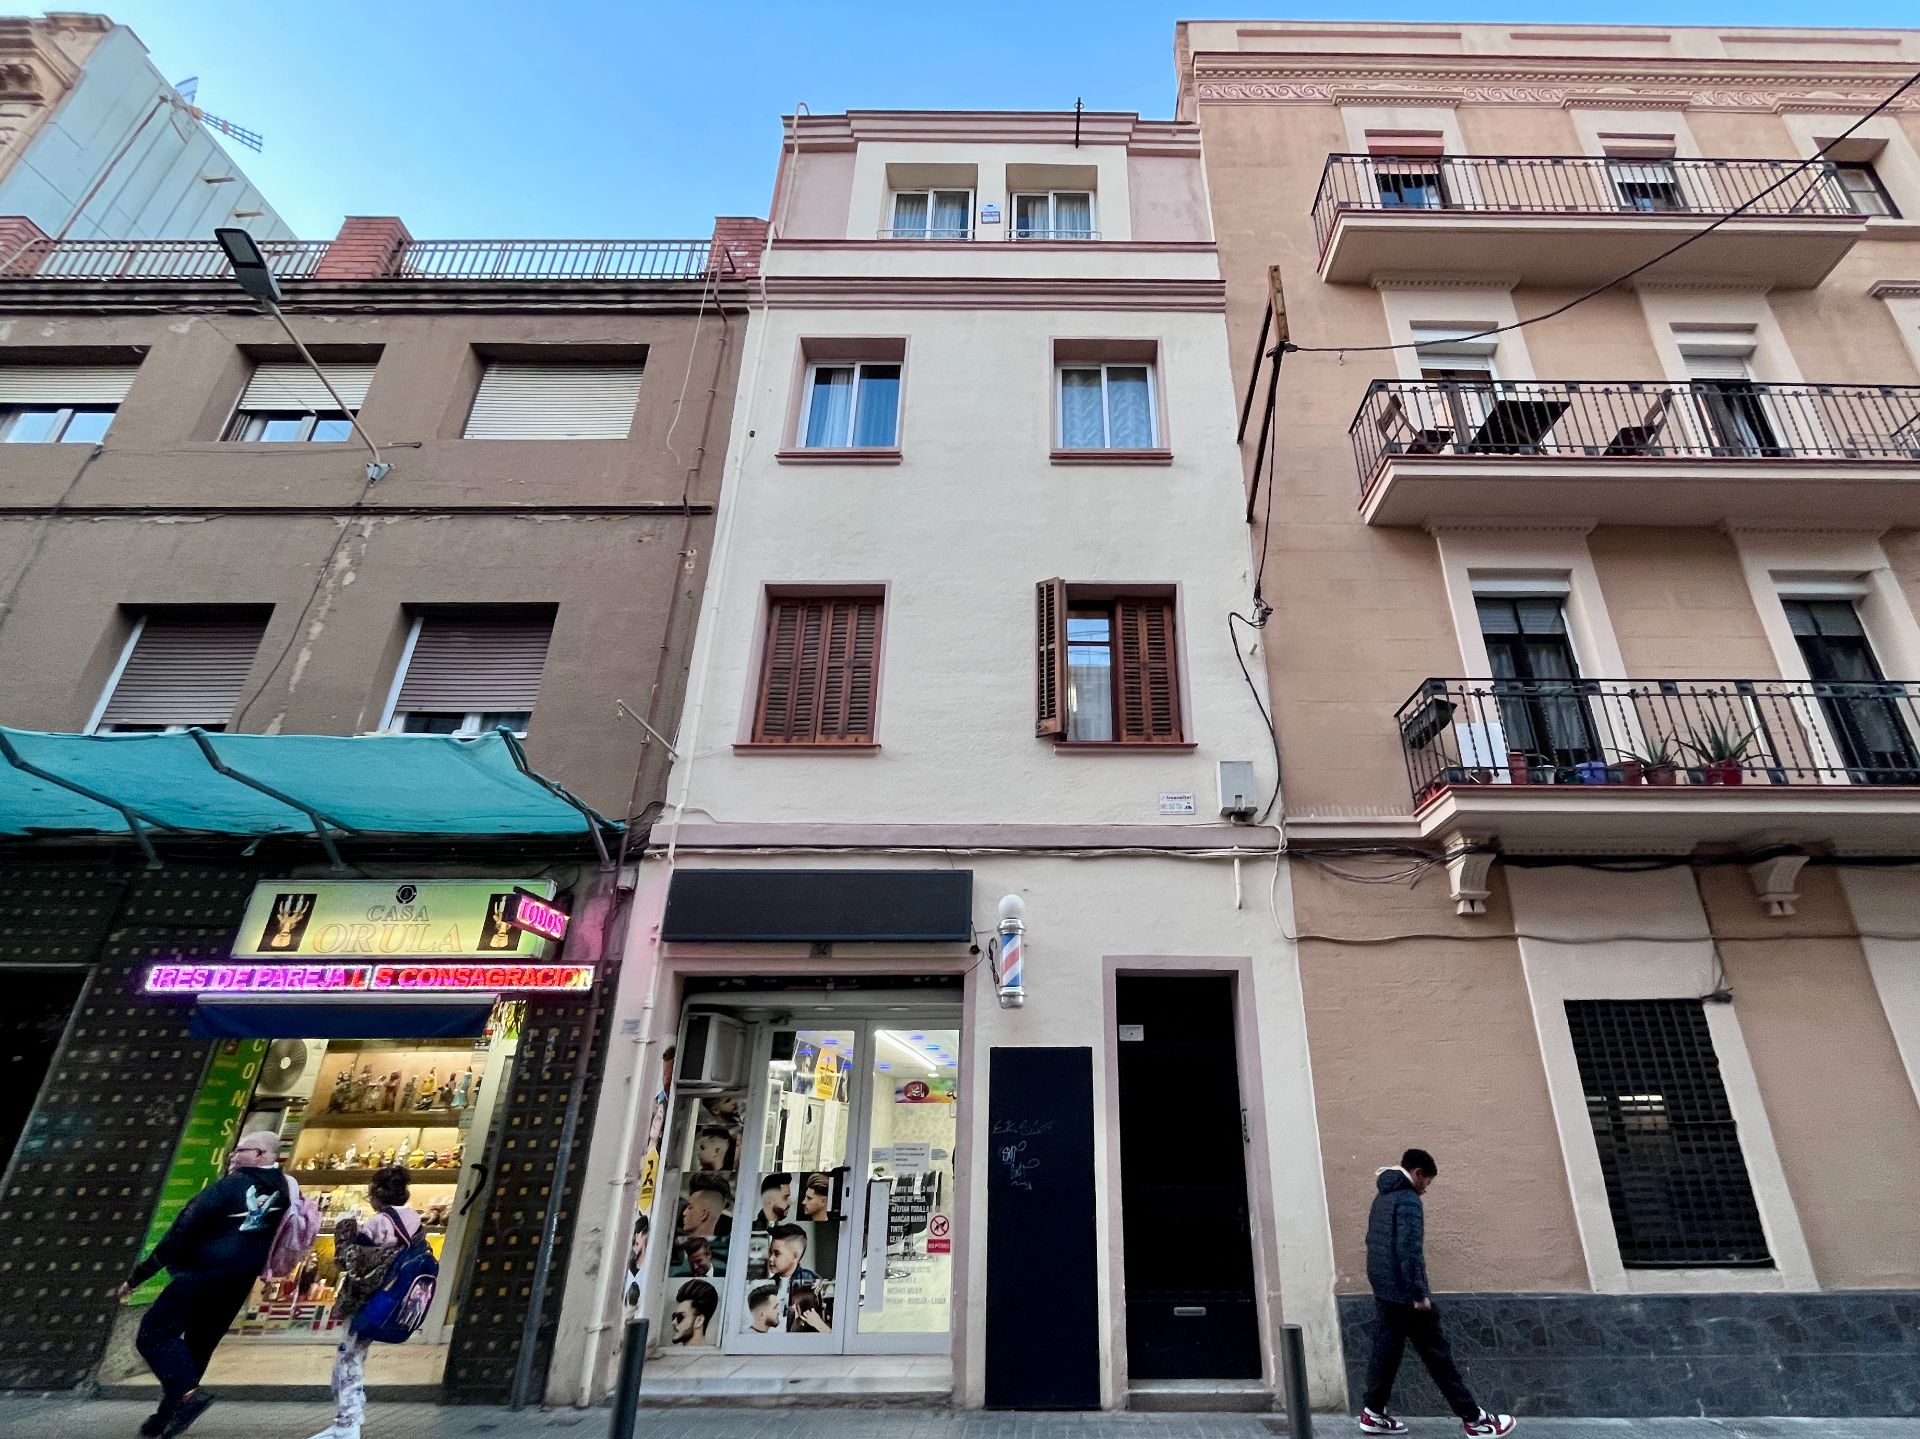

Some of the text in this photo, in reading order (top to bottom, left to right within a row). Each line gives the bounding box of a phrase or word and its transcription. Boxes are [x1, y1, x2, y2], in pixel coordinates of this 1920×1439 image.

[366, 904, 430, 923] CASA
[517, 897, 564, 936] TODOS
[311, 923, 464, 954] ORULA
[211, 968, 251, 988] DE
[254, 968, 345, 988] PAREJA
